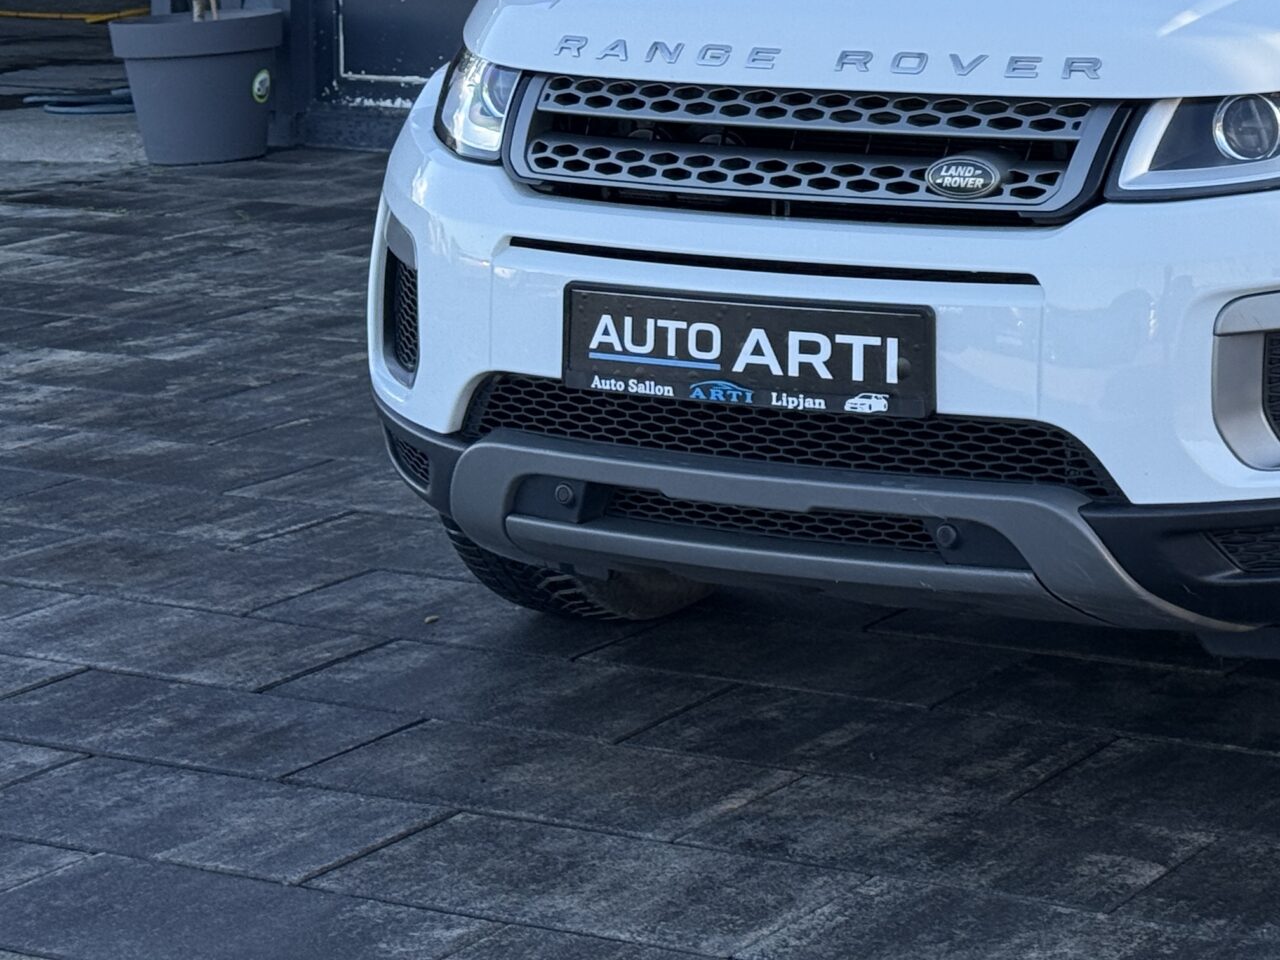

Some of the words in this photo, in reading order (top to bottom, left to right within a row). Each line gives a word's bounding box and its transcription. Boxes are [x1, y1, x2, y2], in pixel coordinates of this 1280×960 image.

[553, 34, 783, 70] RANGE
[833, 49, 1103, 80] ROVER
[940, 165, 975, 177] LAND
[942, 177, 985, 189] ROVER
[588, 313, 722, 361] AUTO
[731, 327, 899, 384] ARTI
[590, 374, 625, 392] Auto
[627, 378, 675, 397] Sallon
[689, 386, 754, 404] ARTI
[770, 391, 827, 411] Lipjan
